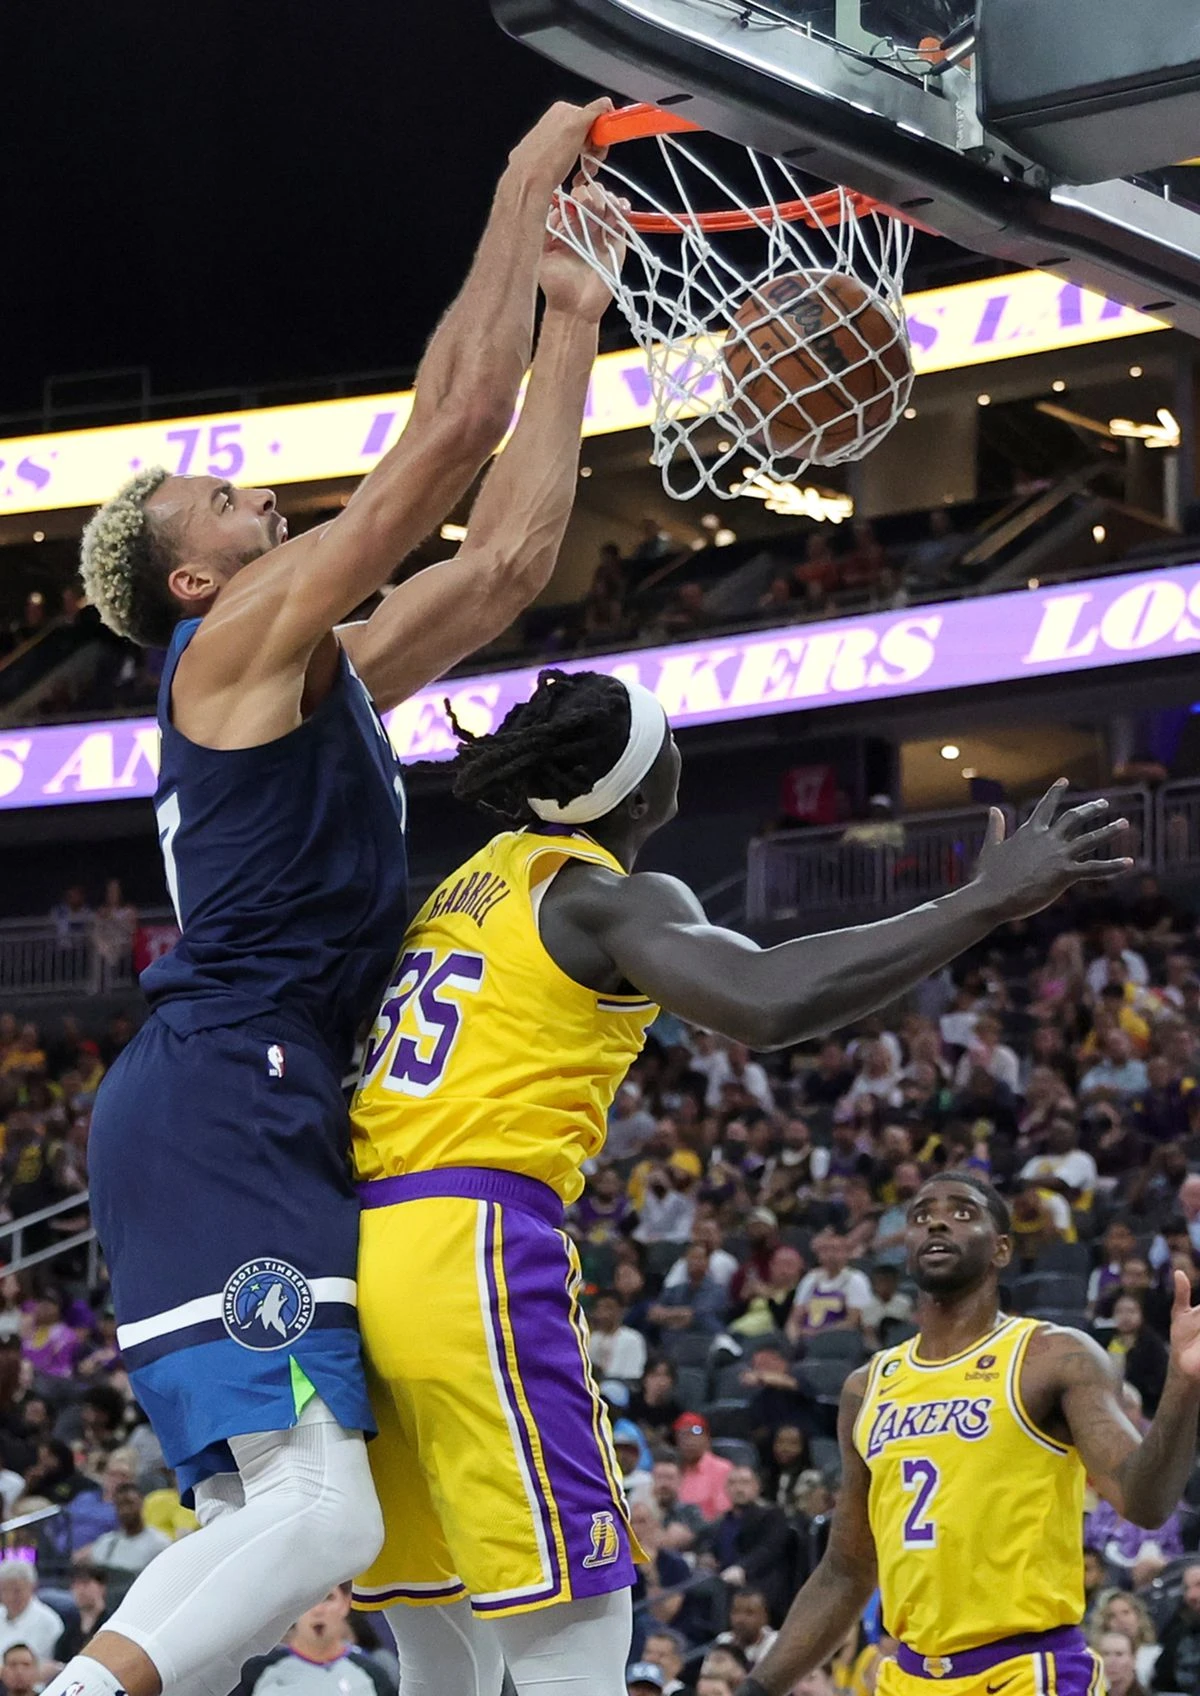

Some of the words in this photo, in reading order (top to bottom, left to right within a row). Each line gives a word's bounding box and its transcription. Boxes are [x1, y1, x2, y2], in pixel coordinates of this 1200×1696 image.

[165, 423, 245, 478] 75
[545, 615, 943, 716] KERS
[426, 871, 511, 929] GABRIEL
[360, 948, 485, 1098] 35
[225, 1264, 260, 1325] MINNESOTA
[264, 1262, 311, 1331] TIMBERWOLVES
[865, 1398, 993, 1459] LAKERS
[901, 1457, 940, 1550] 2
